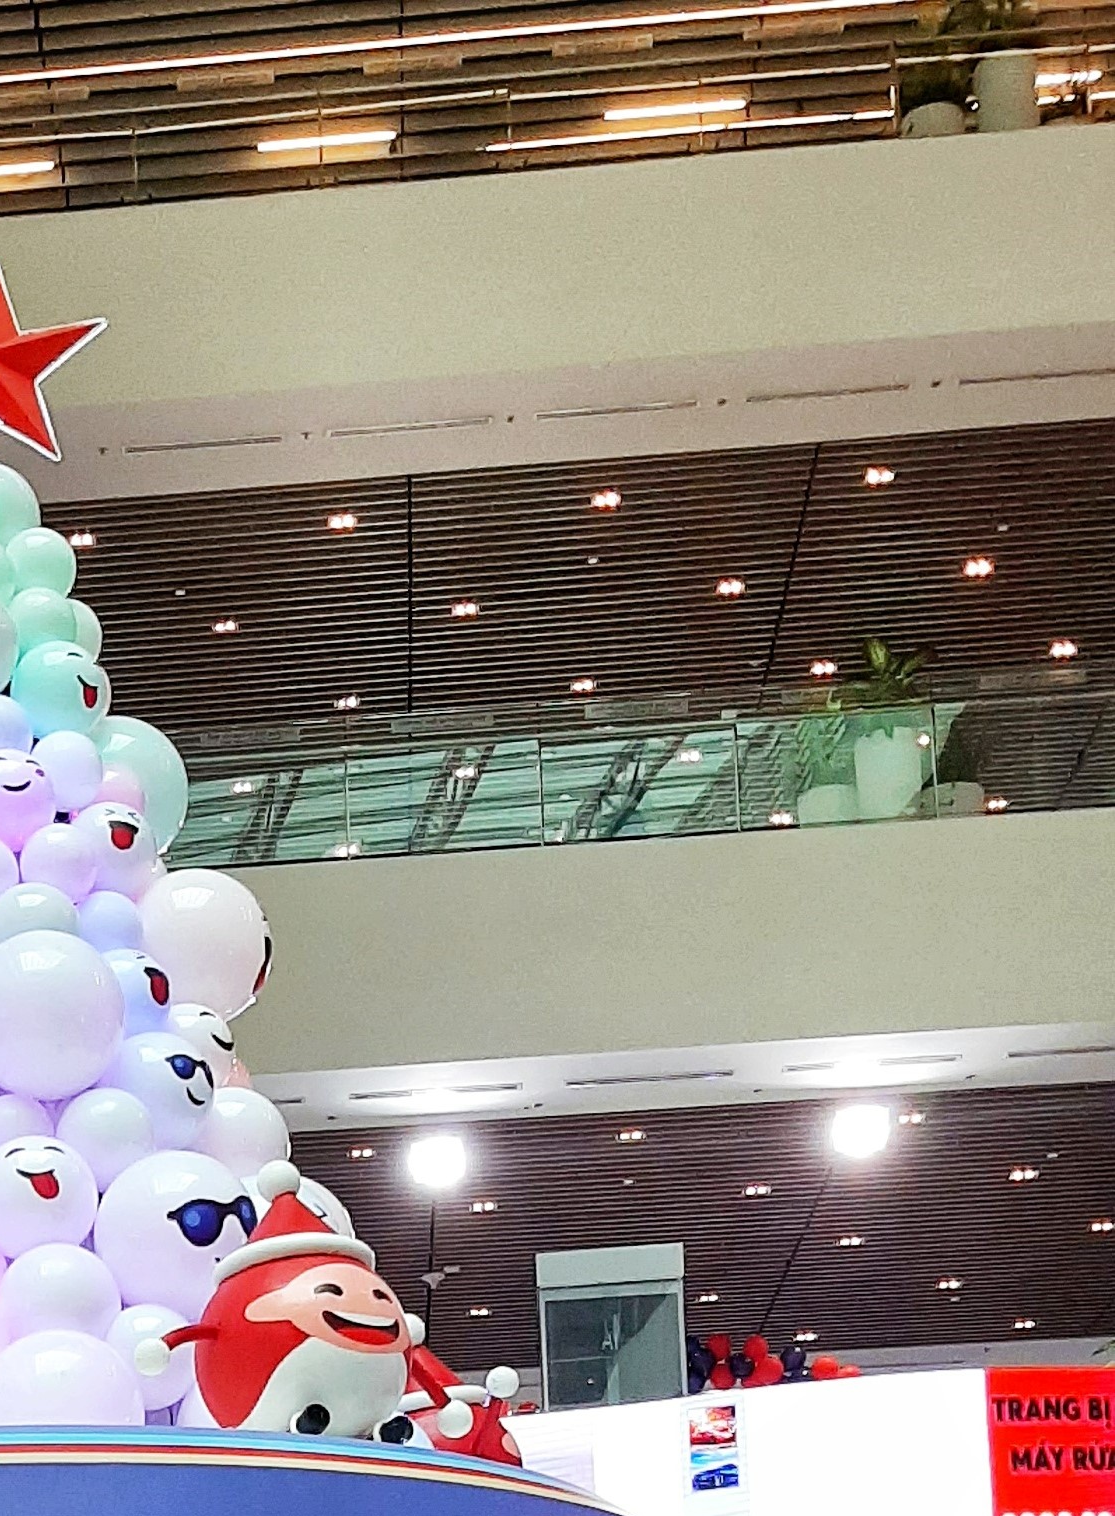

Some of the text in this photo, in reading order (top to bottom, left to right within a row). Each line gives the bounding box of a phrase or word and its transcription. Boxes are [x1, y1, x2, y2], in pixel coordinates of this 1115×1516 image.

[992, 1396, 1111, 1430] TRANG BỊ
[1011, 1439, 1064, 1471] MÁY
